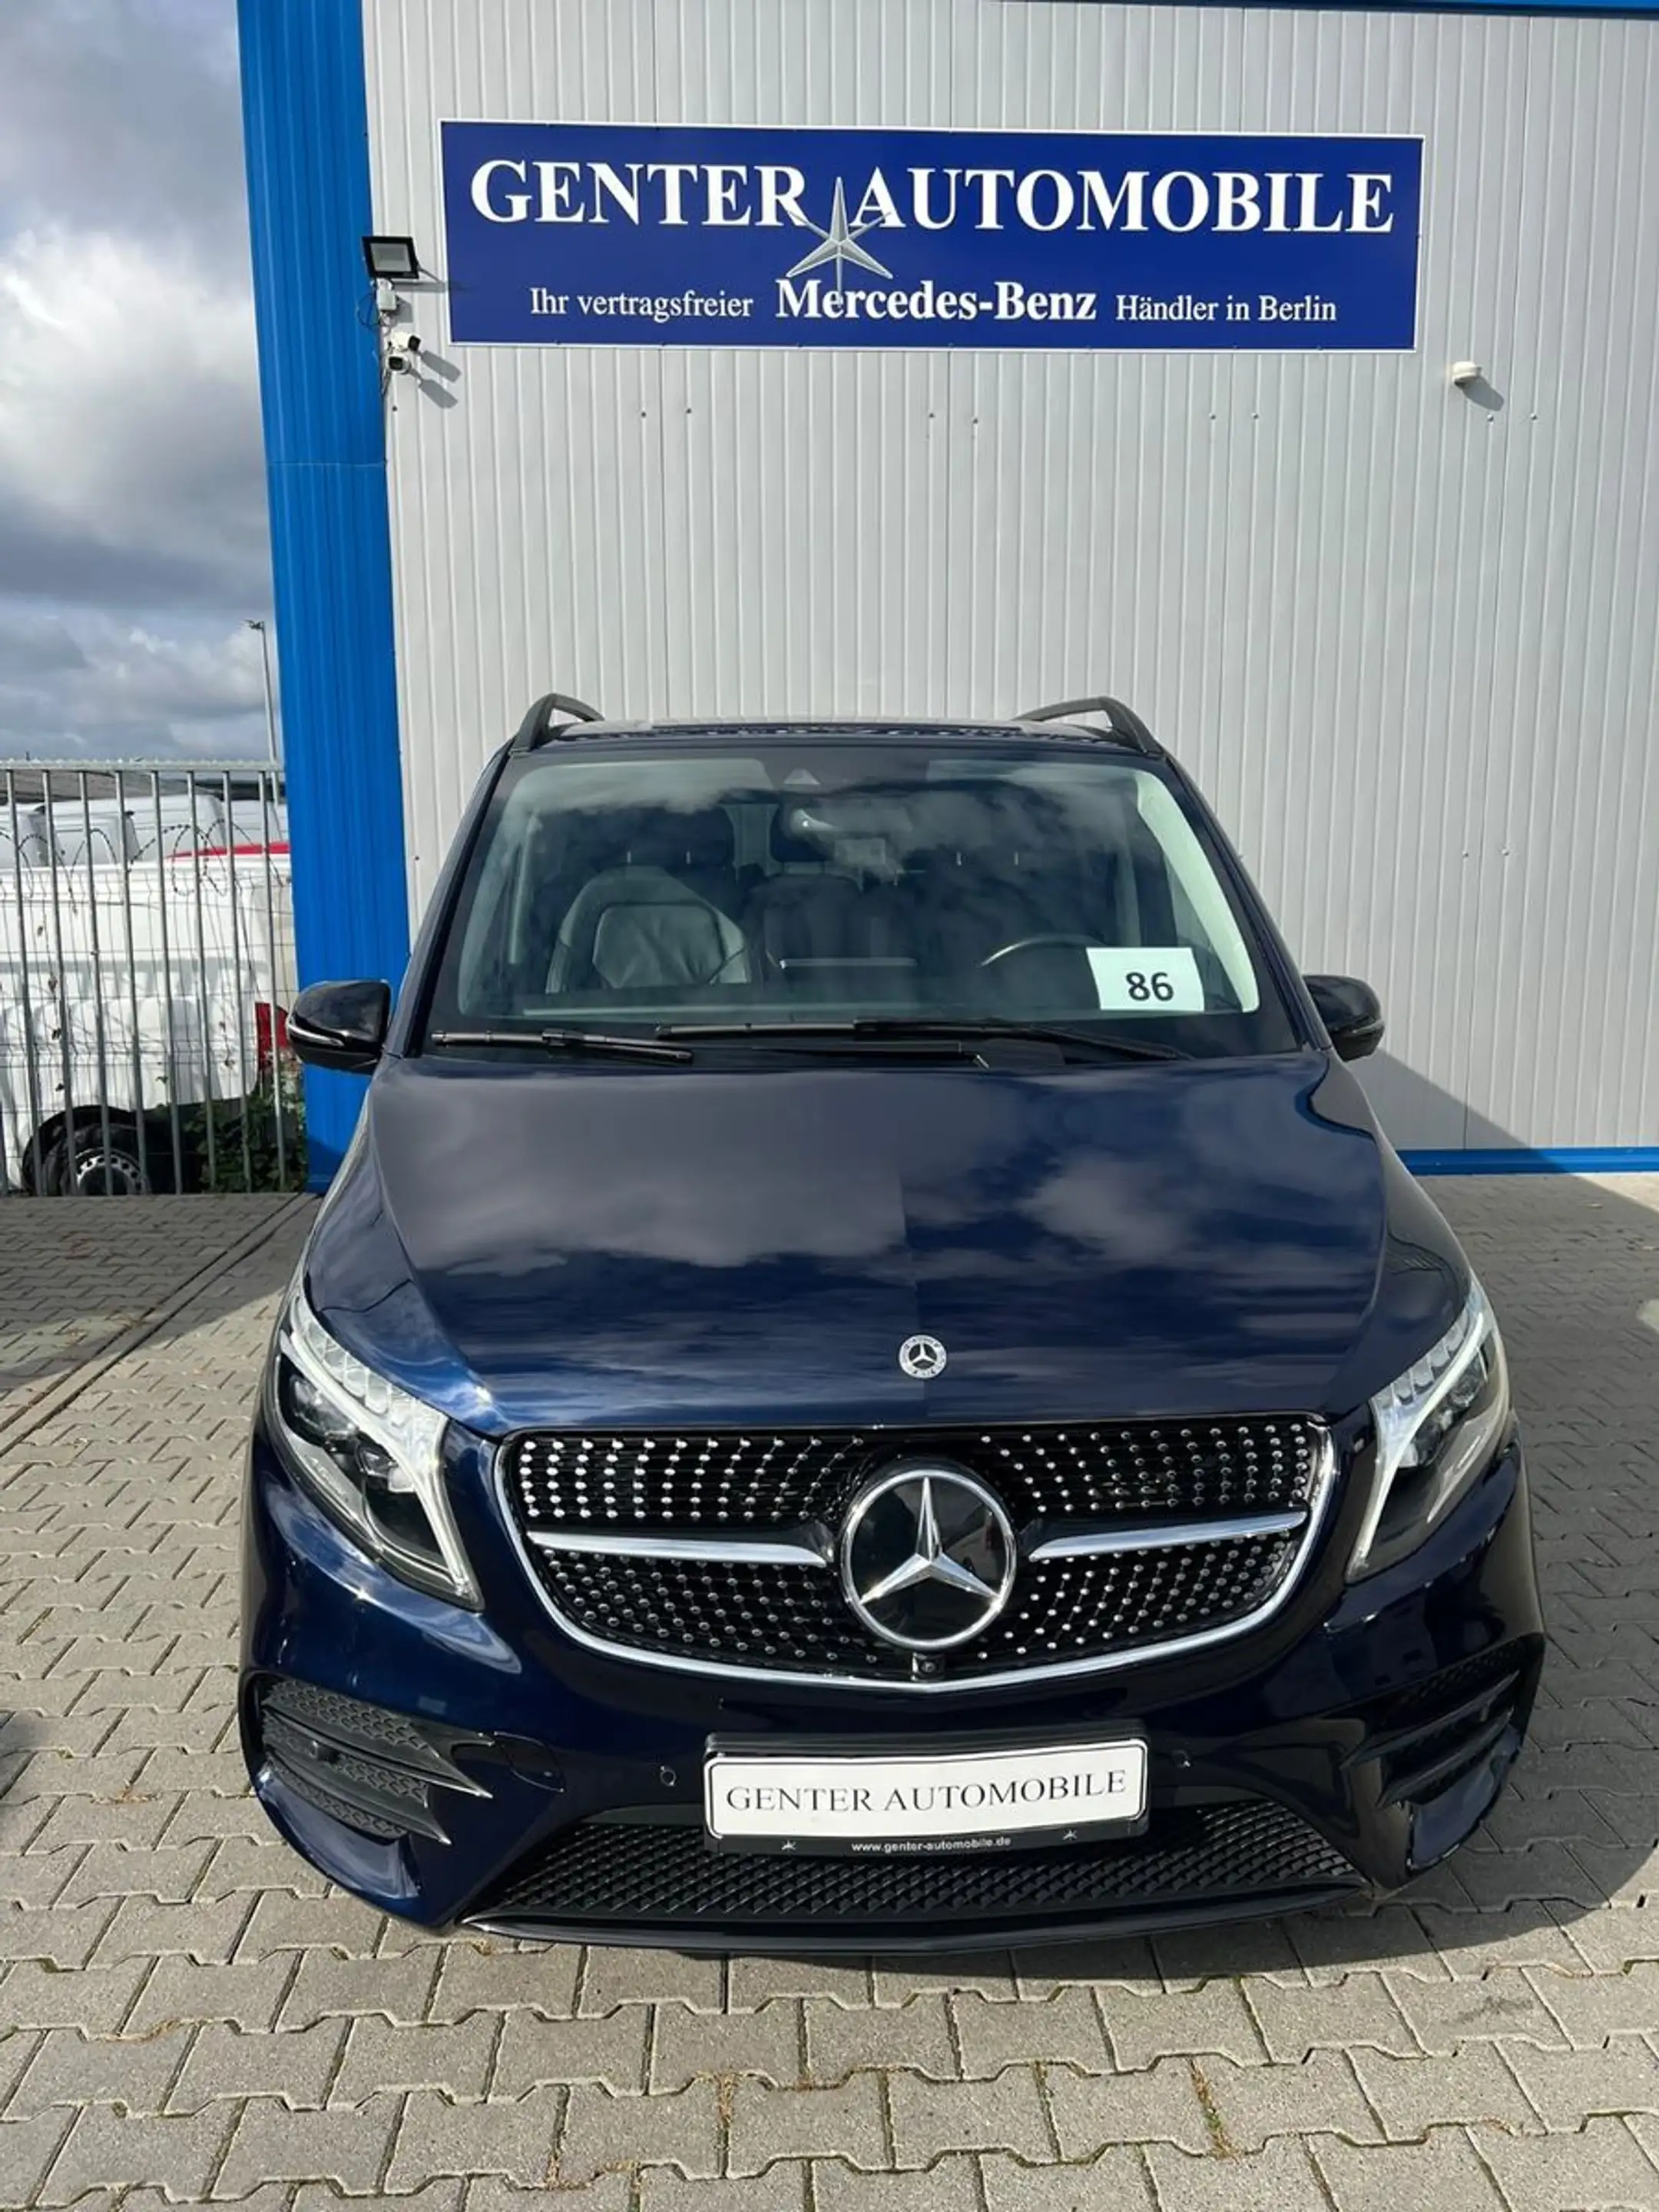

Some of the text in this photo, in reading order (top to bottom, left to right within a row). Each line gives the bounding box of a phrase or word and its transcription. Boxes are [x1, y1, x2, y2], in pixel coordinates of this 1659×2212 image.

[470, 159, 1394, 233] GENTER AUTOMOBILE
[530, 279, 1337, 323] Ihr vertragsfreier Mercedes-Benz Händler in Berlin
[1125, 972, 1174, 1002] 86
[727, 1770, 1127, 1812] GENTER AUTOMOBILE
[851, 1836, 1012, 1853] www.genter-automobile.de
